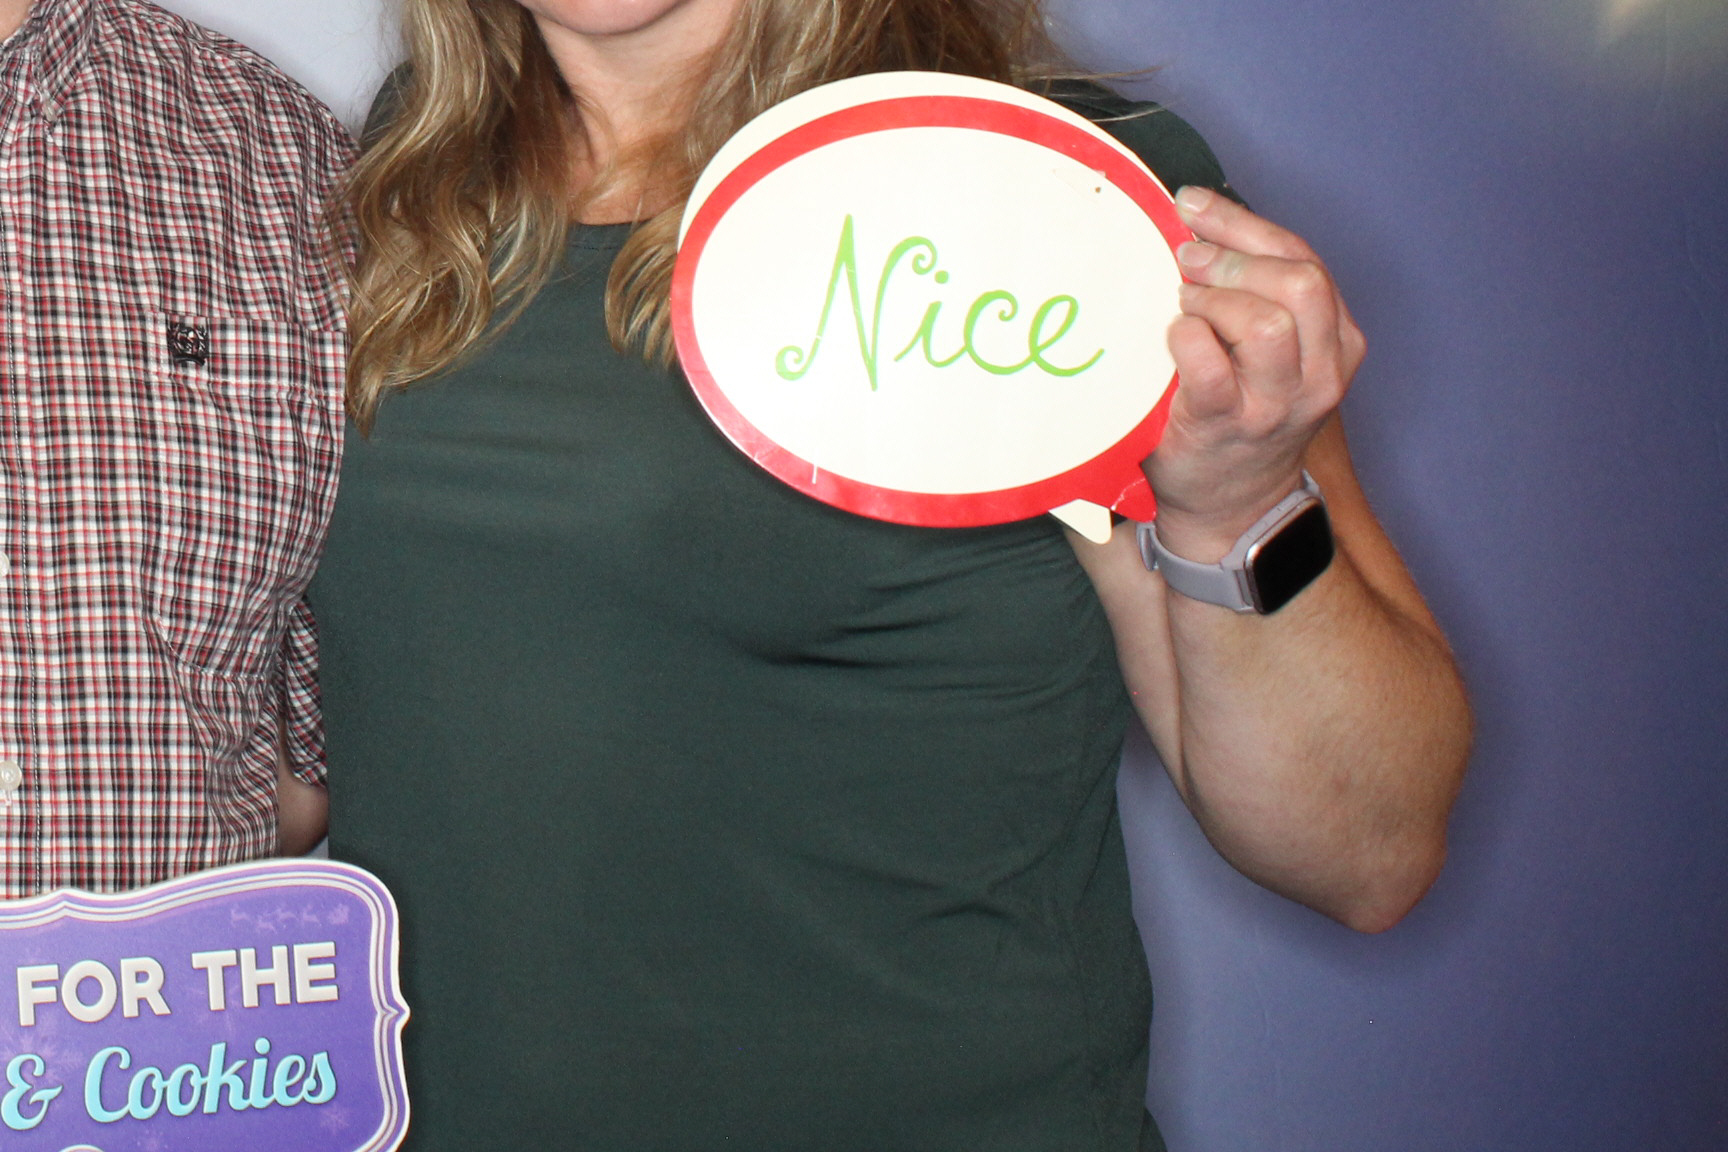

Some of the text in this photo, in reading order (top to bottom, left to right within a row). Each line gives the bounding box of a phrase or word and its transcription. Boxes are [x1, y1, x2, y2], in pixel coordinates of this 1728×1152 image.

[775, 213, 1104, 392] Nice
[16, 956, 171, 1027] FOR
[191, 940, 340, 1011] THE
[0, 1052, 64, 1131] &
[83, 1036, 338, 1123] Cookies
